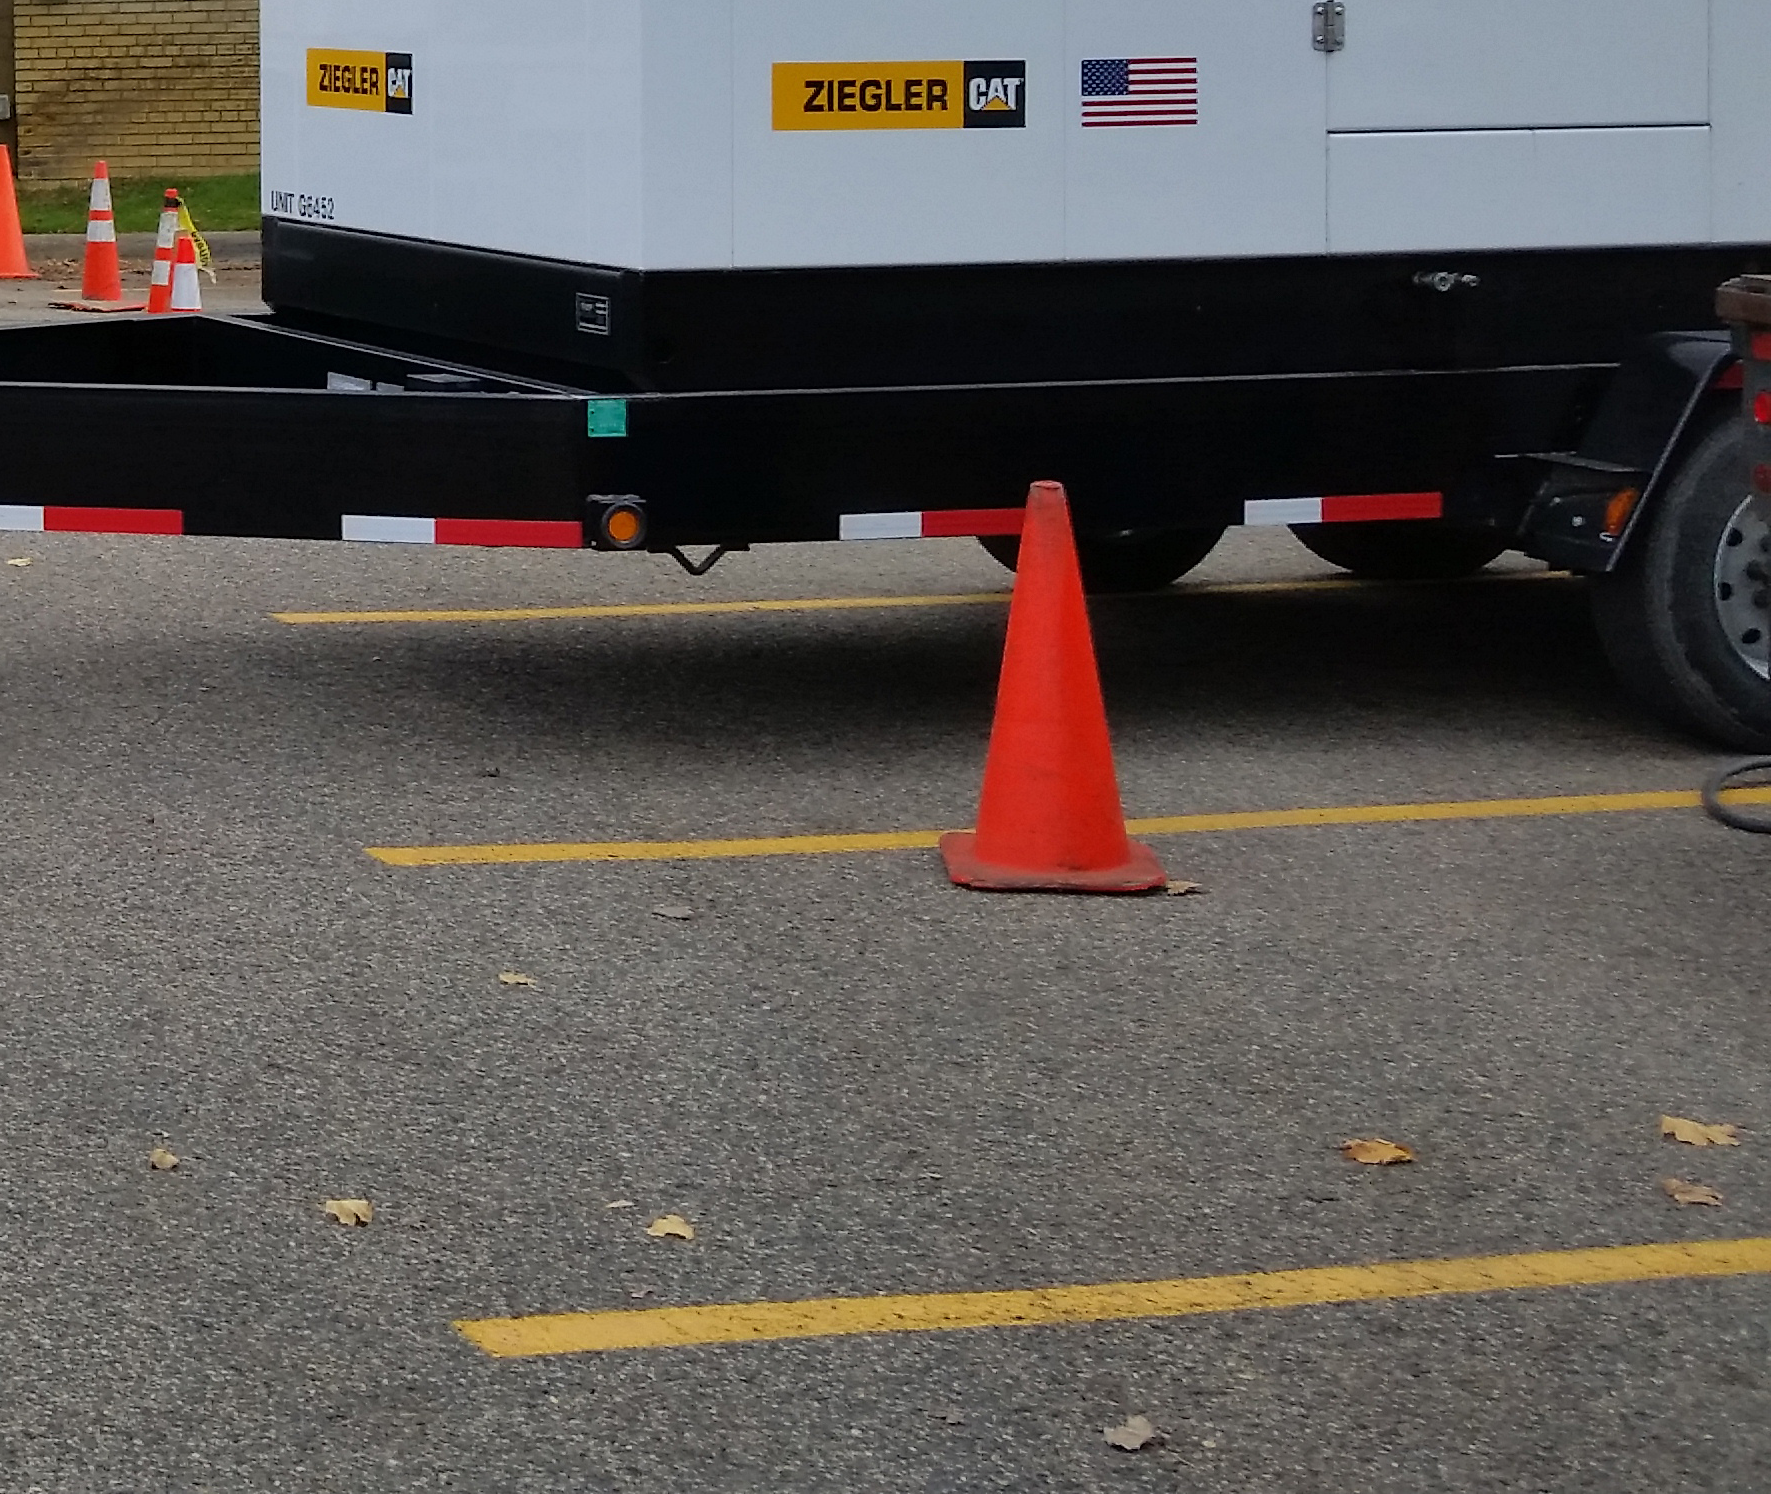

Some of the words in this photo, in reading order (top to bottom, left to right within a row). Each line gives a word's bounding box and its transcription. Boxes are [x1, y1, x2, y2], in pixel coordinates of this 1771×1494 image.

[318, 63, 381, 96] ZIEGLER
[387, 67, 413, 99] CAT
[803, 79, 949, 113] ZIEGLER
[969, 77, 1024, 112] CAT
[271, 189, 295, 214] UNIT
